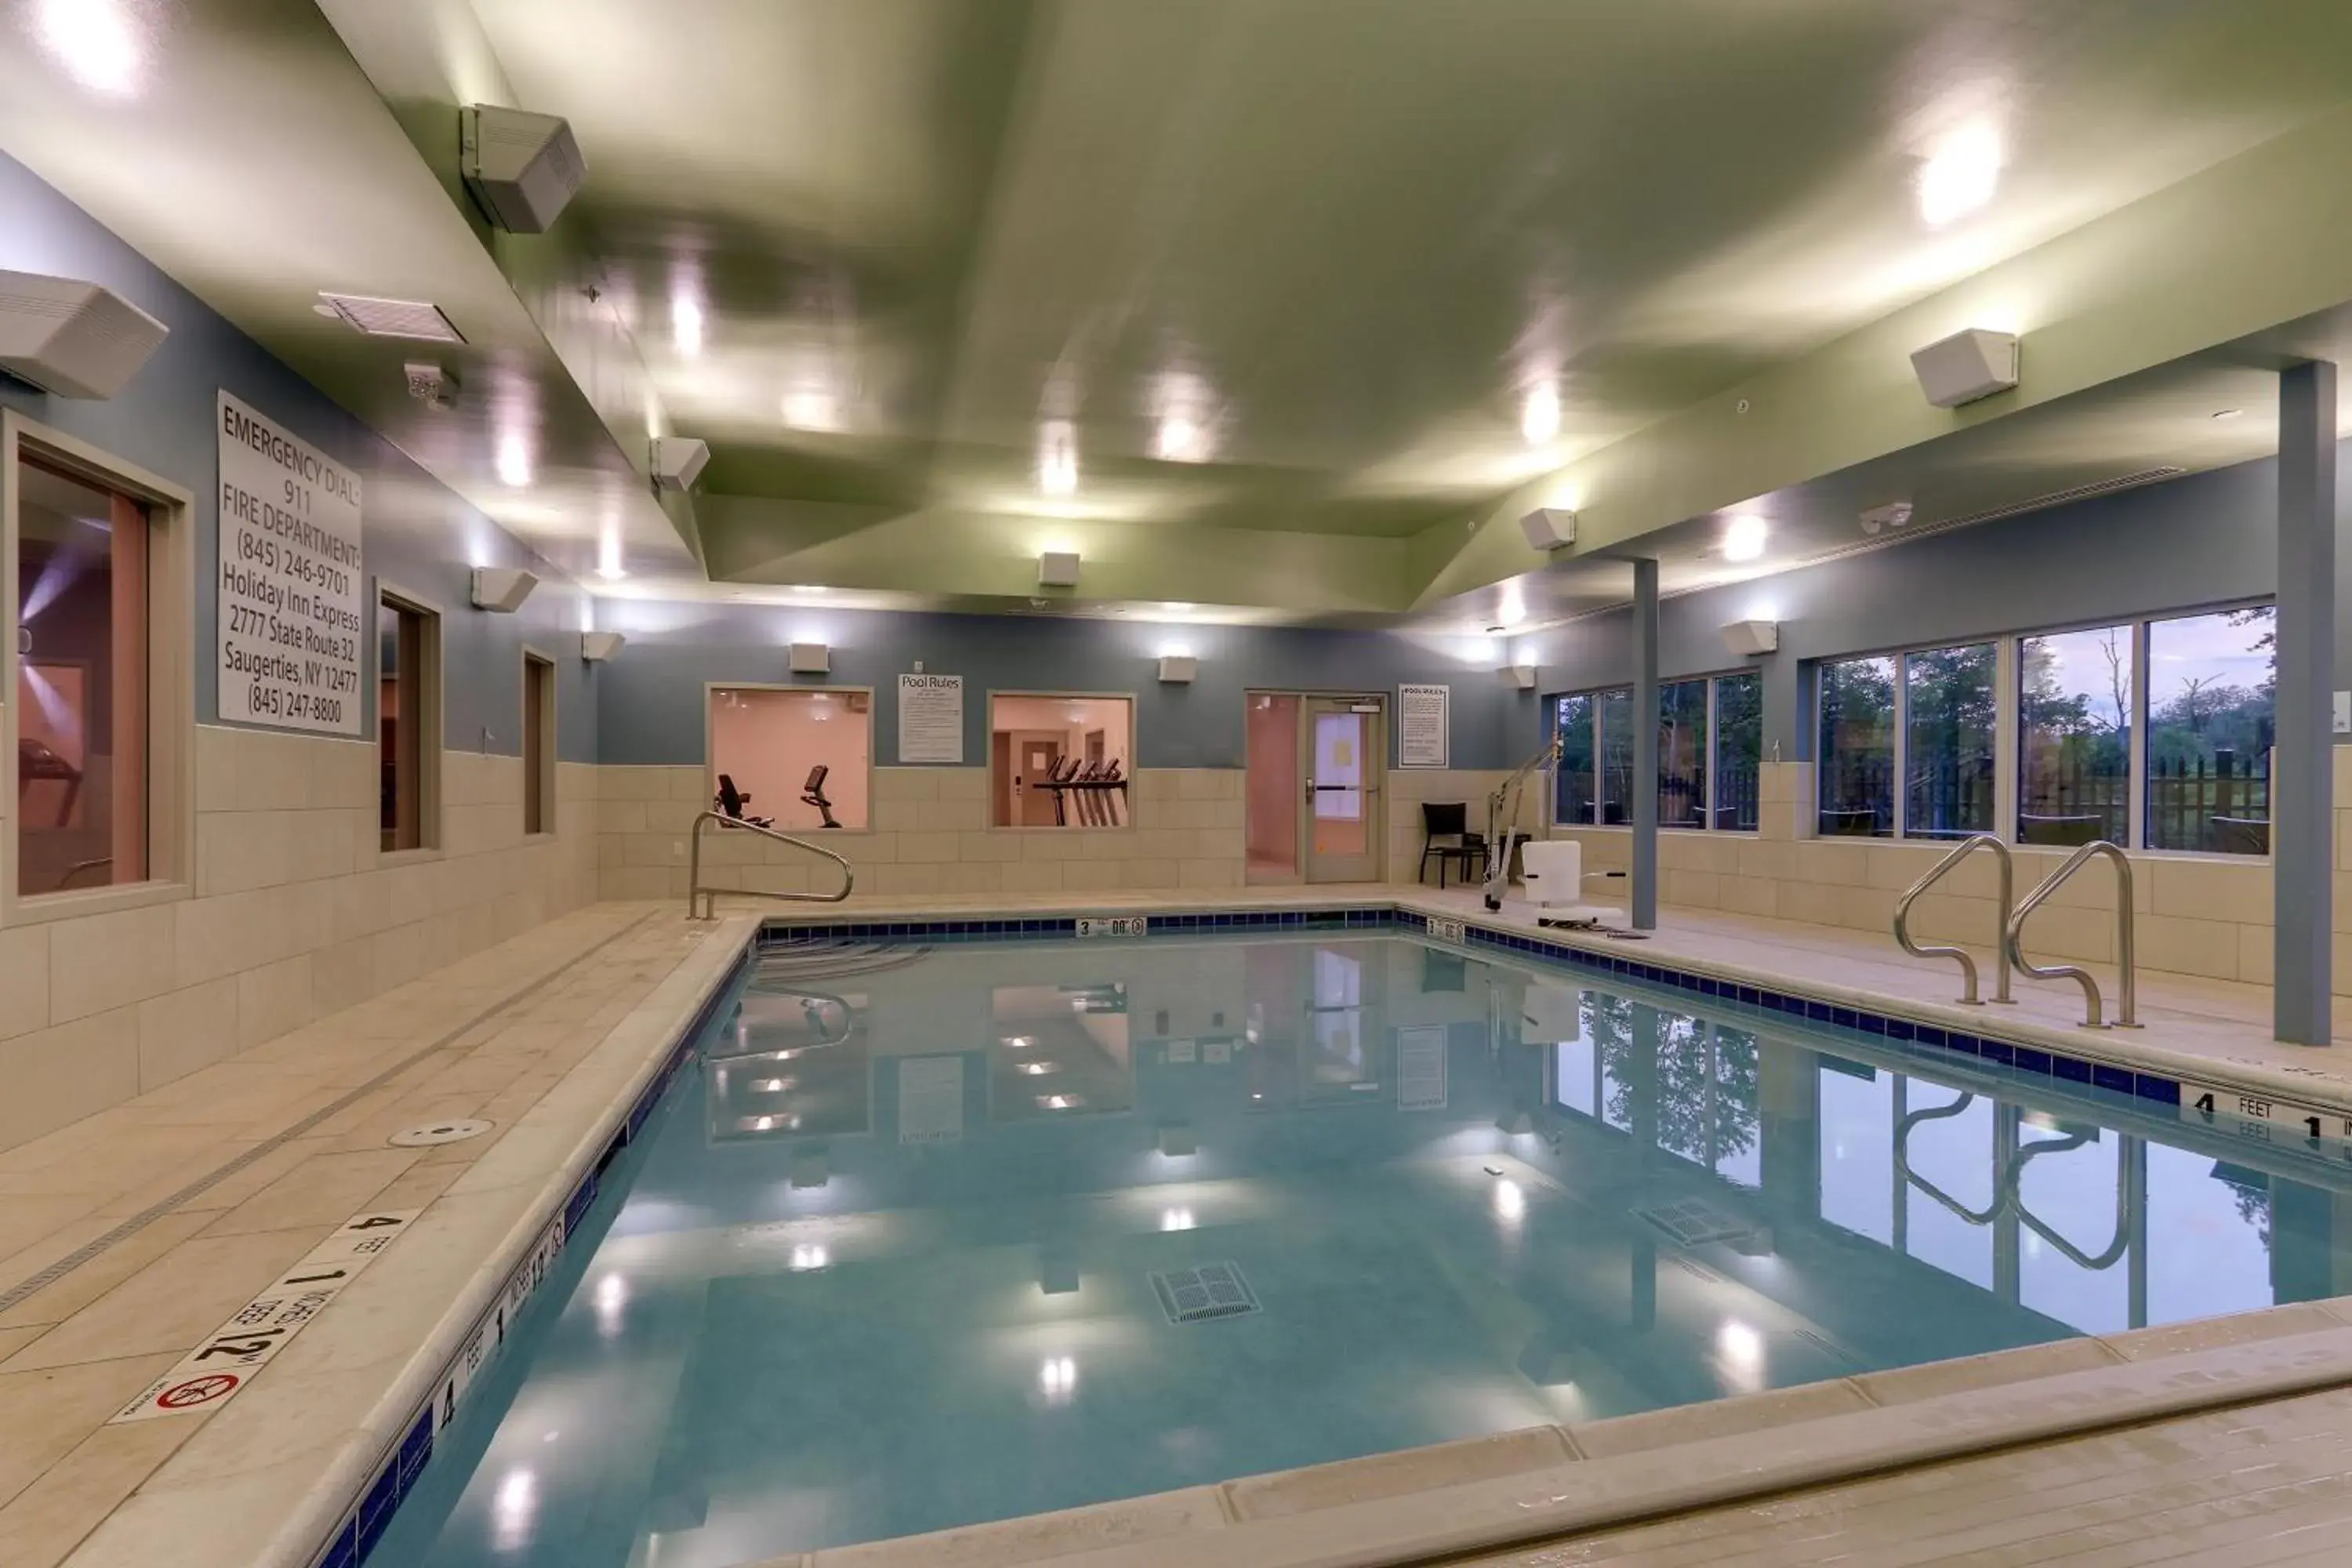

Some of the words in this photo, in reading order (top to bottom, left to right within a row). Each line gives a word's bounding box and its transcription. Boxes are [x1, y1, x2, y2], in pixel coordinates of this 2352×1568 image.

[224, 405, 322, 485] EMERGENCY
[325, 467, 358, 507] DIAL:
[285, 479, 310, 514] 911
[223, 482, 260, 526] FIRE
[263, 503, 360, 571] DEPARTMENT:
[238, 528, 280, 574] (845)
[285, 550, 349, 596] 246-9701
[223, 561, 284, 614] Holiday
[287, 585, 310, 616] Inn
[314, 595, 359, 632] Express
[230, 604, 265, 637] 2777
[269, 615, 302, 648] State
[305, 626, 339, 659] Route
[342, 637, 354, 662] 32
[225, 641, 302, 687] Saugerties,
[305, 659, 322, 687] NY
[325, 665, 358, 694] 12477
[902, 676, 927, 688] Pool
[930, 677, 959, 688] Rules
[249, 683, 282, 720] (845)
[286, 691, 341, 723] 247-8800
[2239, 1098, 2272, 1119] FEET
[2303, 1116, 2321, 1138] 1
[348, 1217, 403, 1229] 4
[284, 1269, 347, 1284] 1
